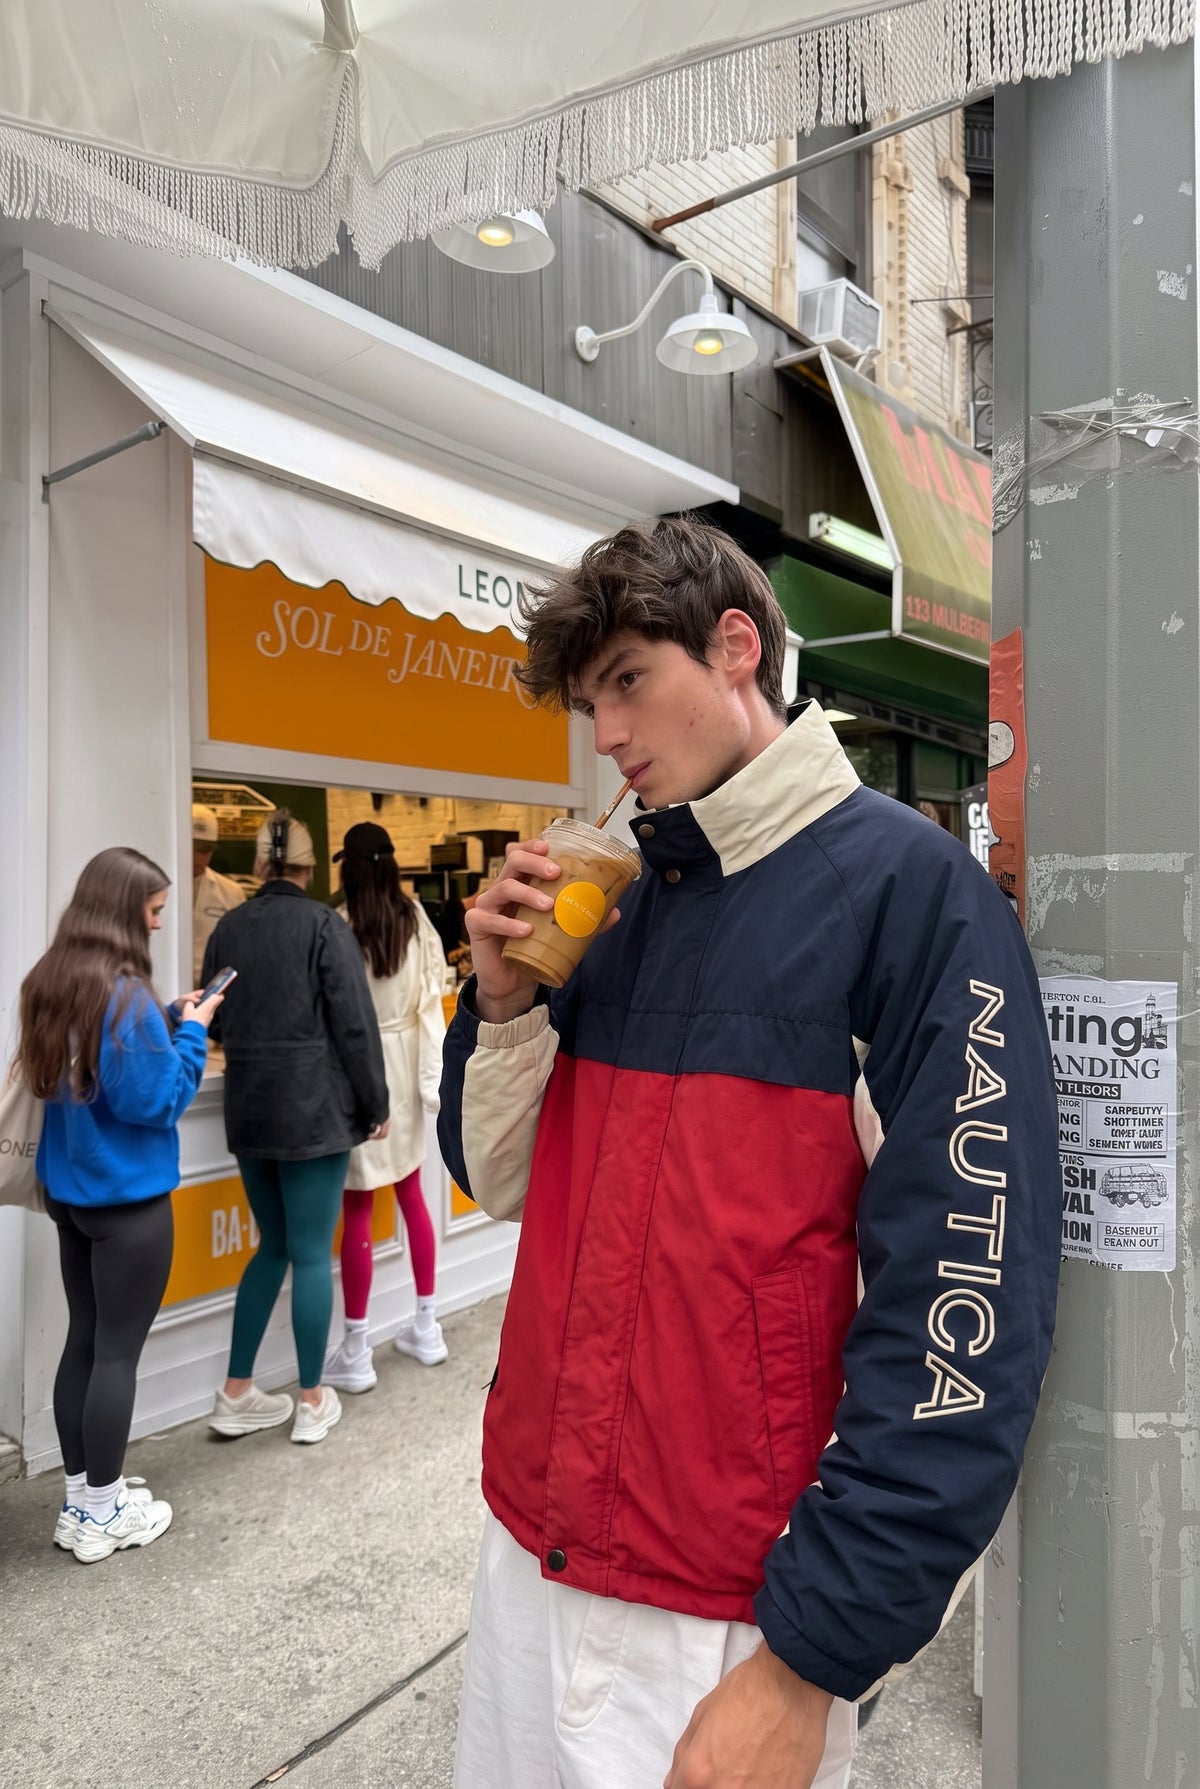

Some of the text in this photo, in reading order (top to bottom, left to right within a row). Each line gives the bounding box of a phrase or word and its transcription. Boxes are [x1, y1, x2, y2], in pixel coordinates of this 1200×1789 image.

[256, 600, 343, 658] SOL
[350, 620, 391, 657] DE
[1048, 1005, 1142, 1057] ting
[912, 978, 1008, 1421] NAUTICA
[1139, 1238, 1160, 1248] OUT
